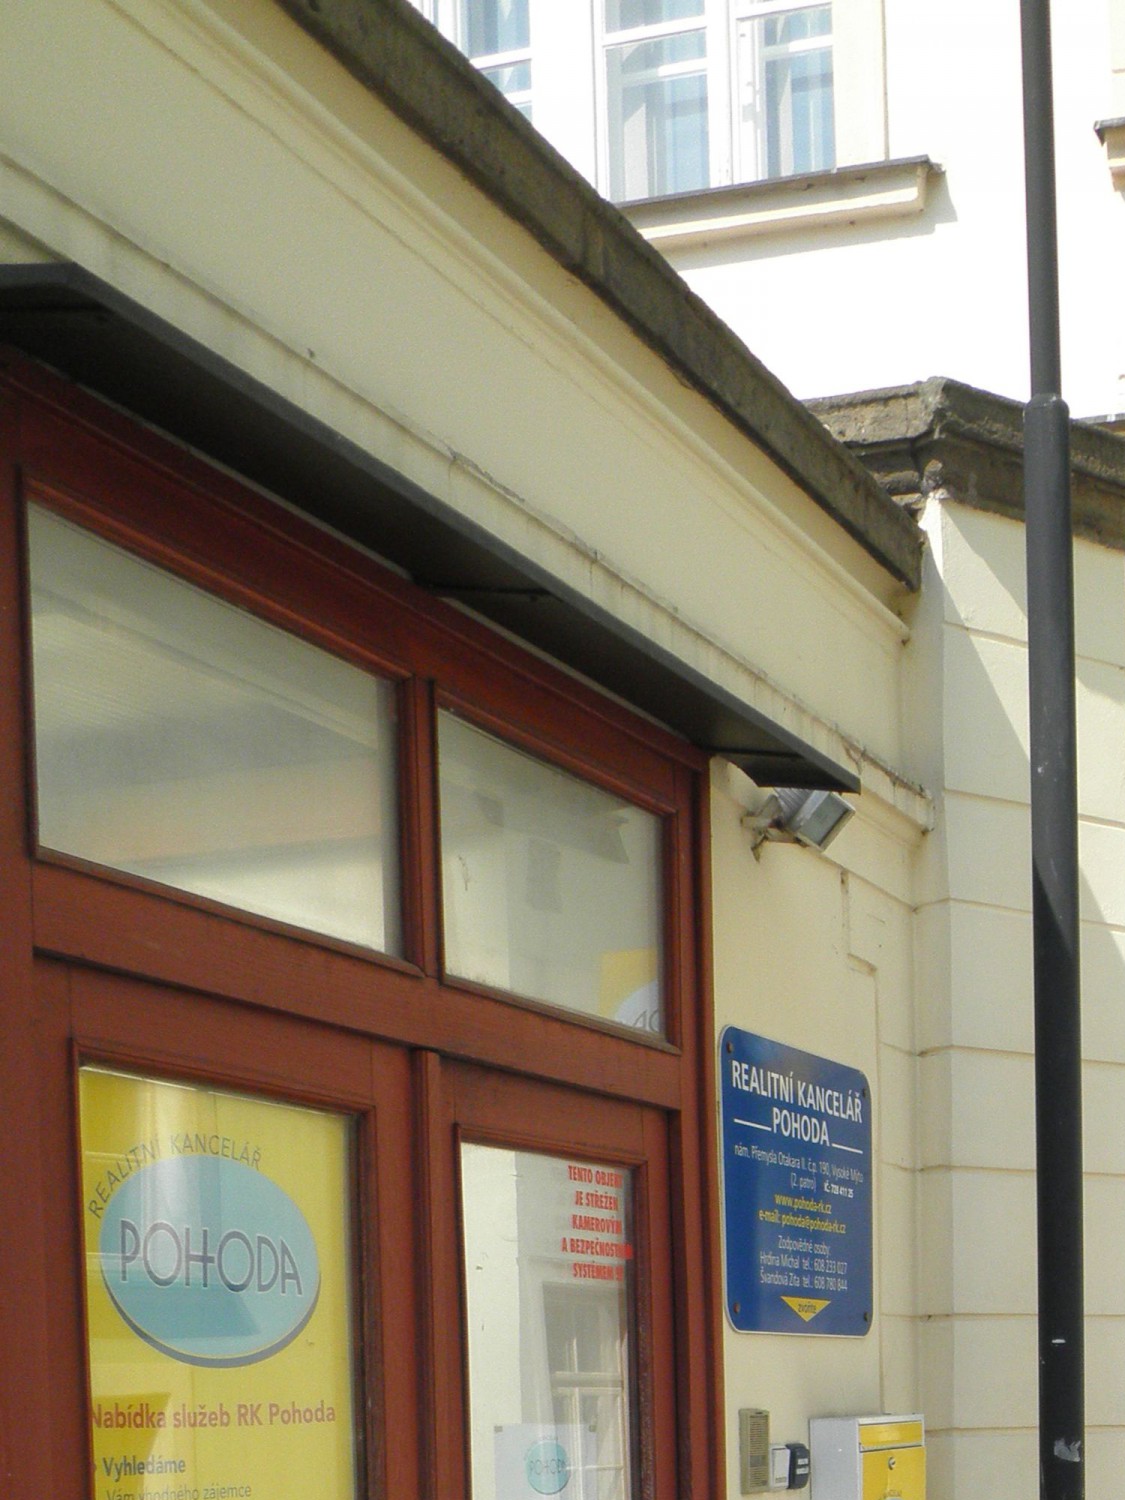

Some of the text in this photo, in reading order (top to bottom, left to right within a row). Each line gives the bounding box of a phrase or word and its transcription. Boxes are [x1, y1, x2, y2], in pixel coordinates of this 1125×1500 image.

[732, 1060, 863, 1123] REALITNÍ KANCELÁŘ
[772, 1107, 830, 1147] POHODA
[88, 1133, 262, 1219] REALITNÍ KANCELÁŘ
[568, 1165, 593, 1184] TENTO
[575, 1190, 618, 1211] JE STŘEŽEN
[120, 1219, 302, 1295] POHODA
[561, 1237, 568, 1252] A
[92, 1400, 336, 1429] Nabídka služeb RK Pohoda
[102, 1455, 186, 1482] Vyhledáme
